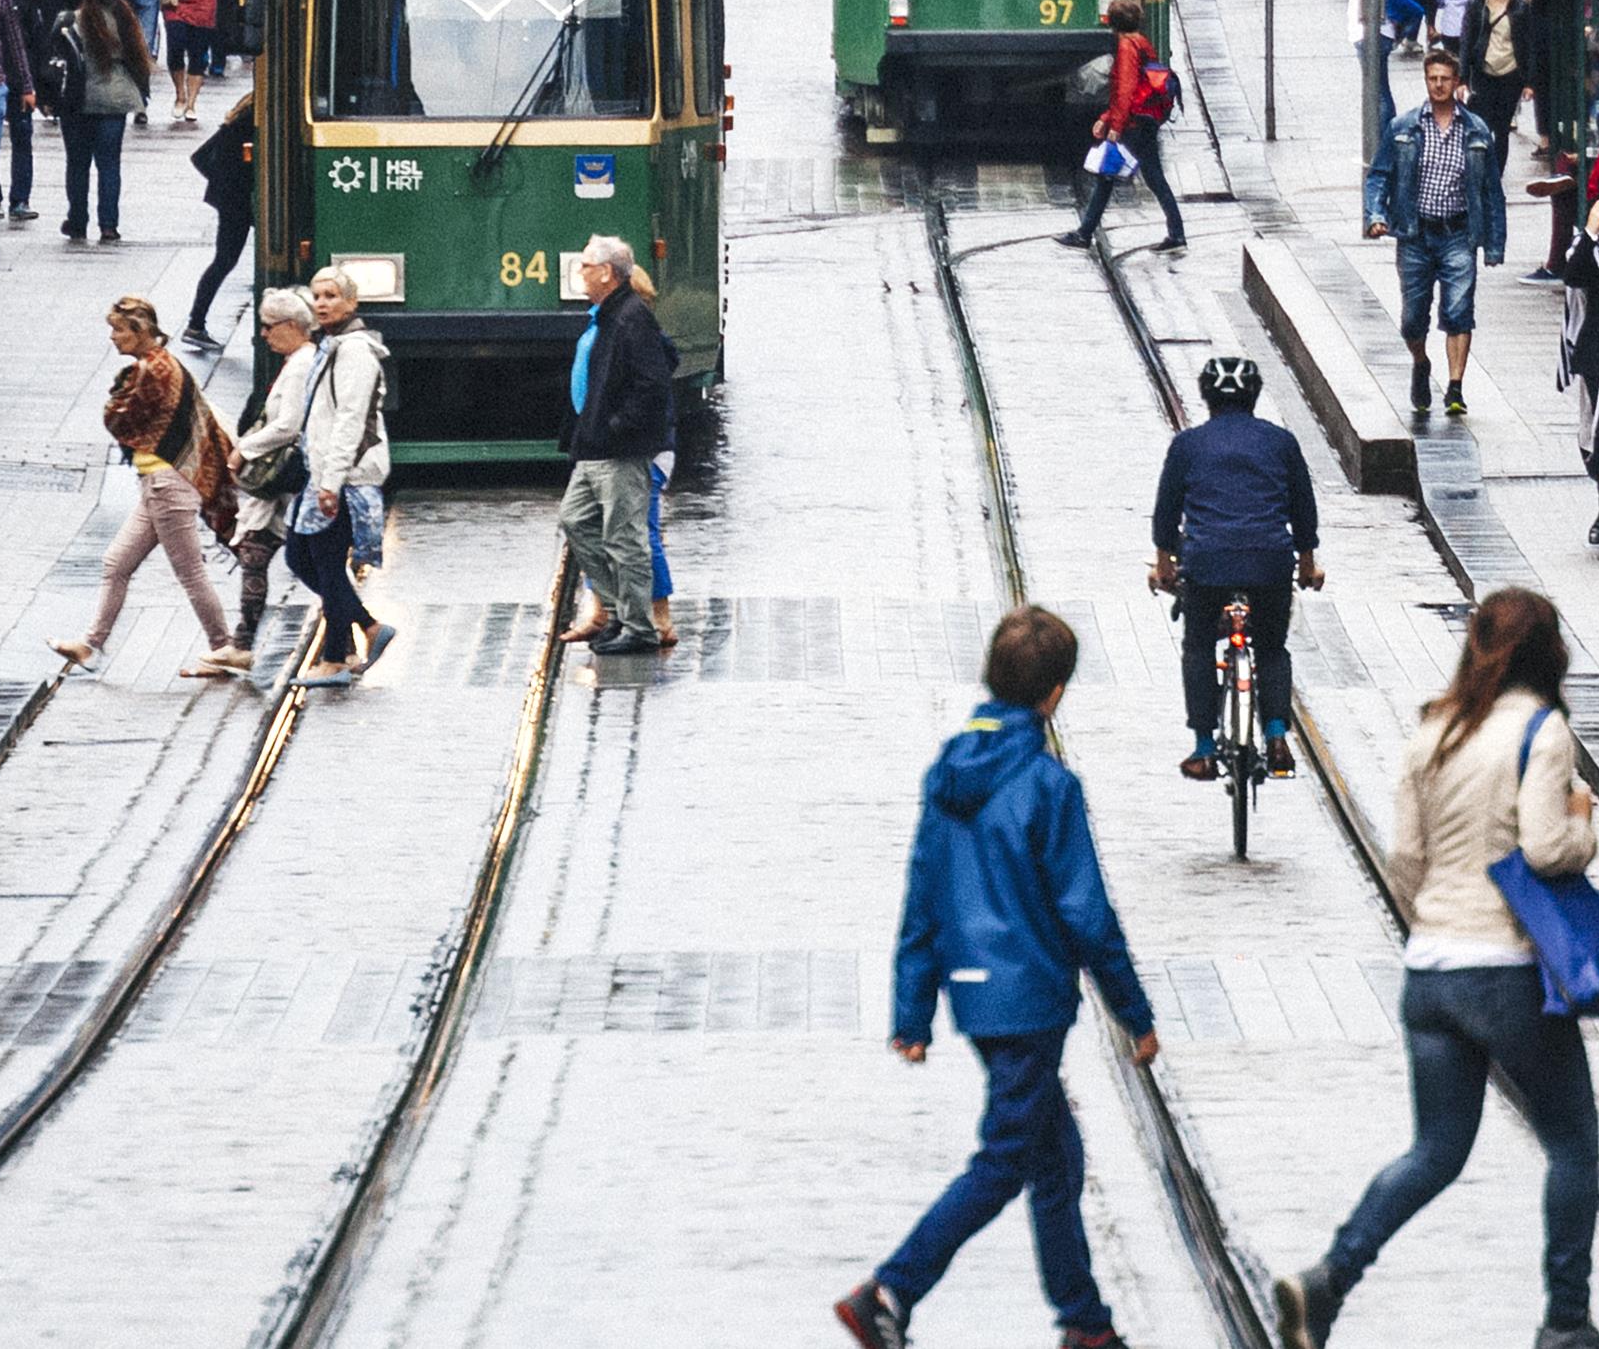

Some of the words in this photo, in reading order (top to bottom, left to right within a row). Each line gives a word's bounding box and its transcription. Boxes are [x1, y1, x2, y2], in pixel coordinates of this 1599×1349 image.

[386, 159, 423, 175] HSL
[386, 175, 423, 191] HRT
[500, 250, 549, 287] 84
